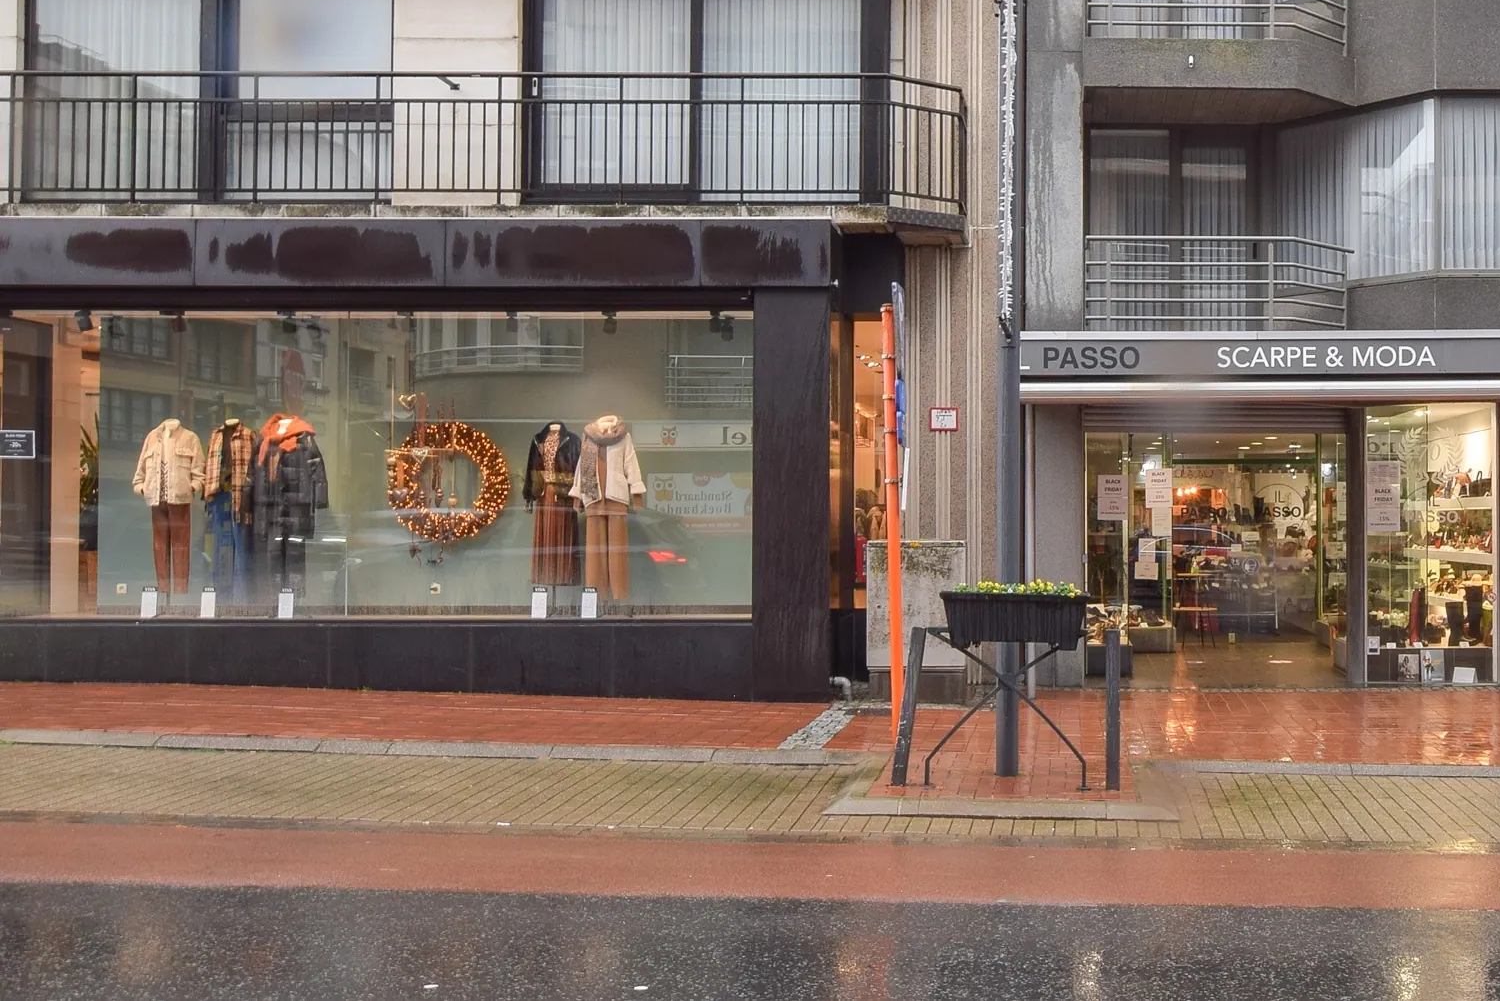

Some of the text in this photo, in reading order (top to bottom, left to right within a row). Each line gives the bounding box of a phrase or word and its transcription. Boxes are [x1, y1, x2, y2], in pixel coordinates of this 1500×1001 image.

[1020, 346, 1140, 369] L PASSO
[1217, 346, 1437, 368] SCARPE & MODA
[1274, 491, 1284, 503] IL
[1428, 495, 1440, 506] IL
[1256, 506, 1302, 518] ASSO
